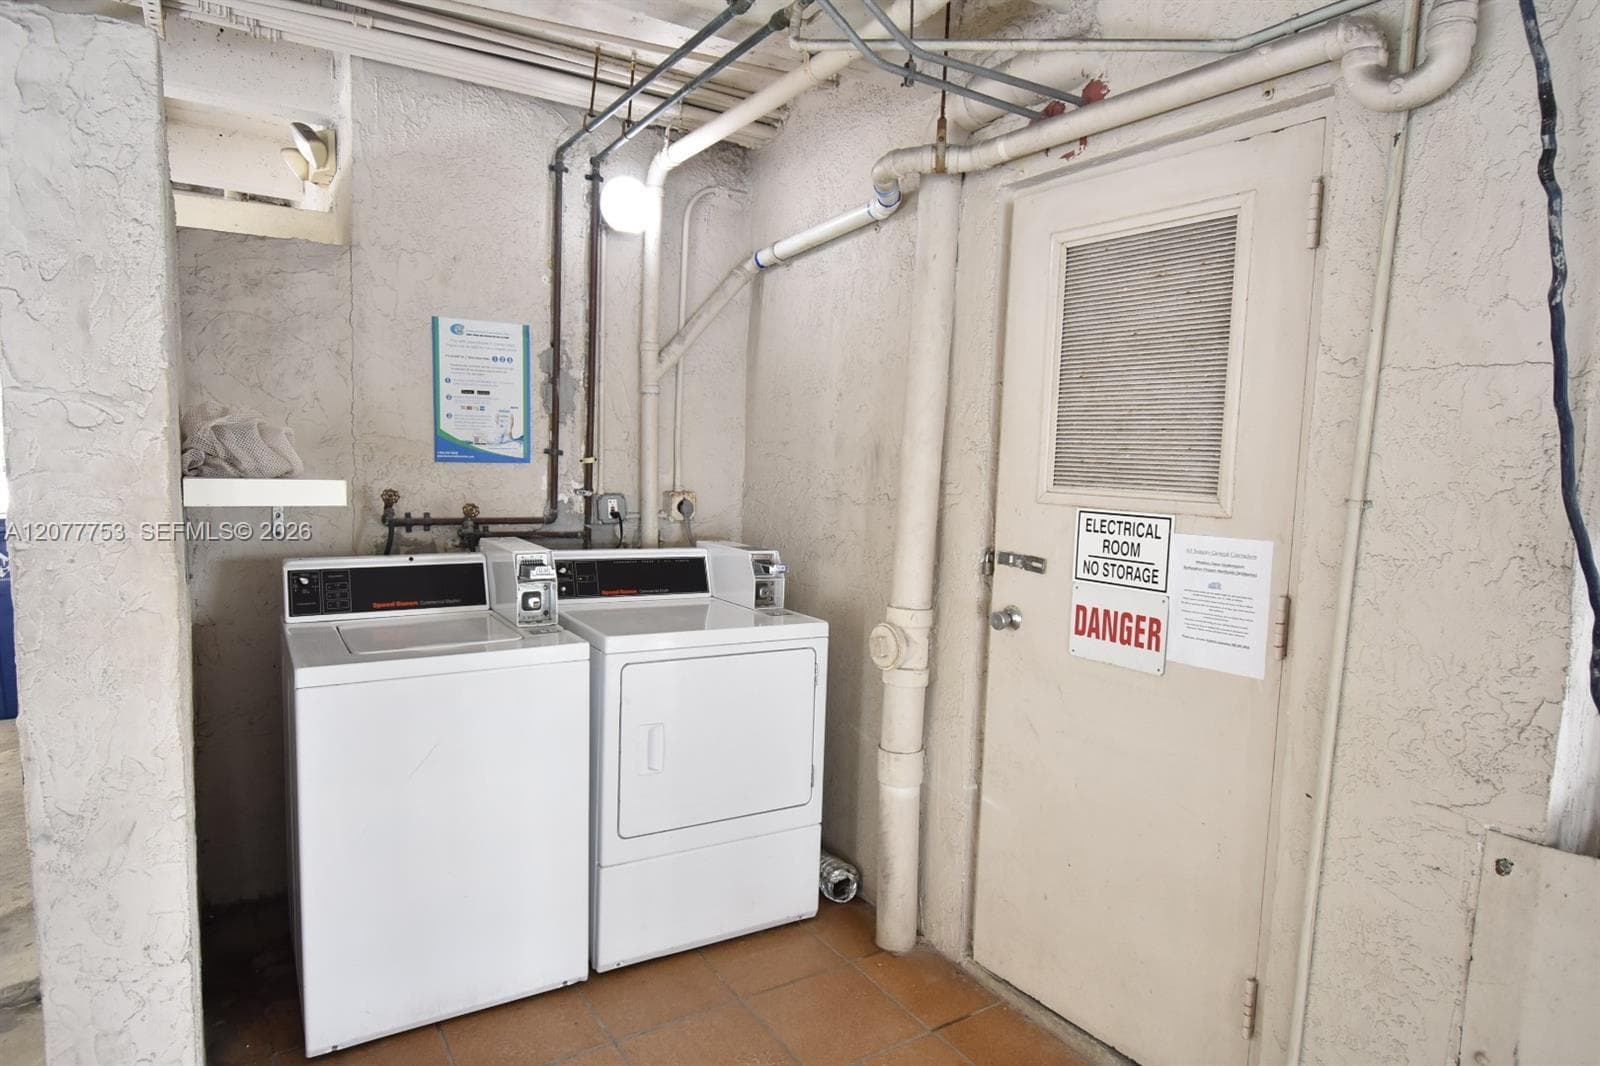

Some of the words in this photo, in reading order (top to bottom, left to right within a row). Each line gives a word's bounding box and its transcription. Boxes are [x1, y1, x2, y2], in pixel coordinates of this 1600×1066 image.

[1085, 518, 1162, 539] ELECTRICAL
[1102, 539, 1141, 558] ROOM
[1082, 560, 1099, 576] NO
[1102, 562, 1159, 584] STORAGE
[1074, 604, 1162, 653] DANGER
